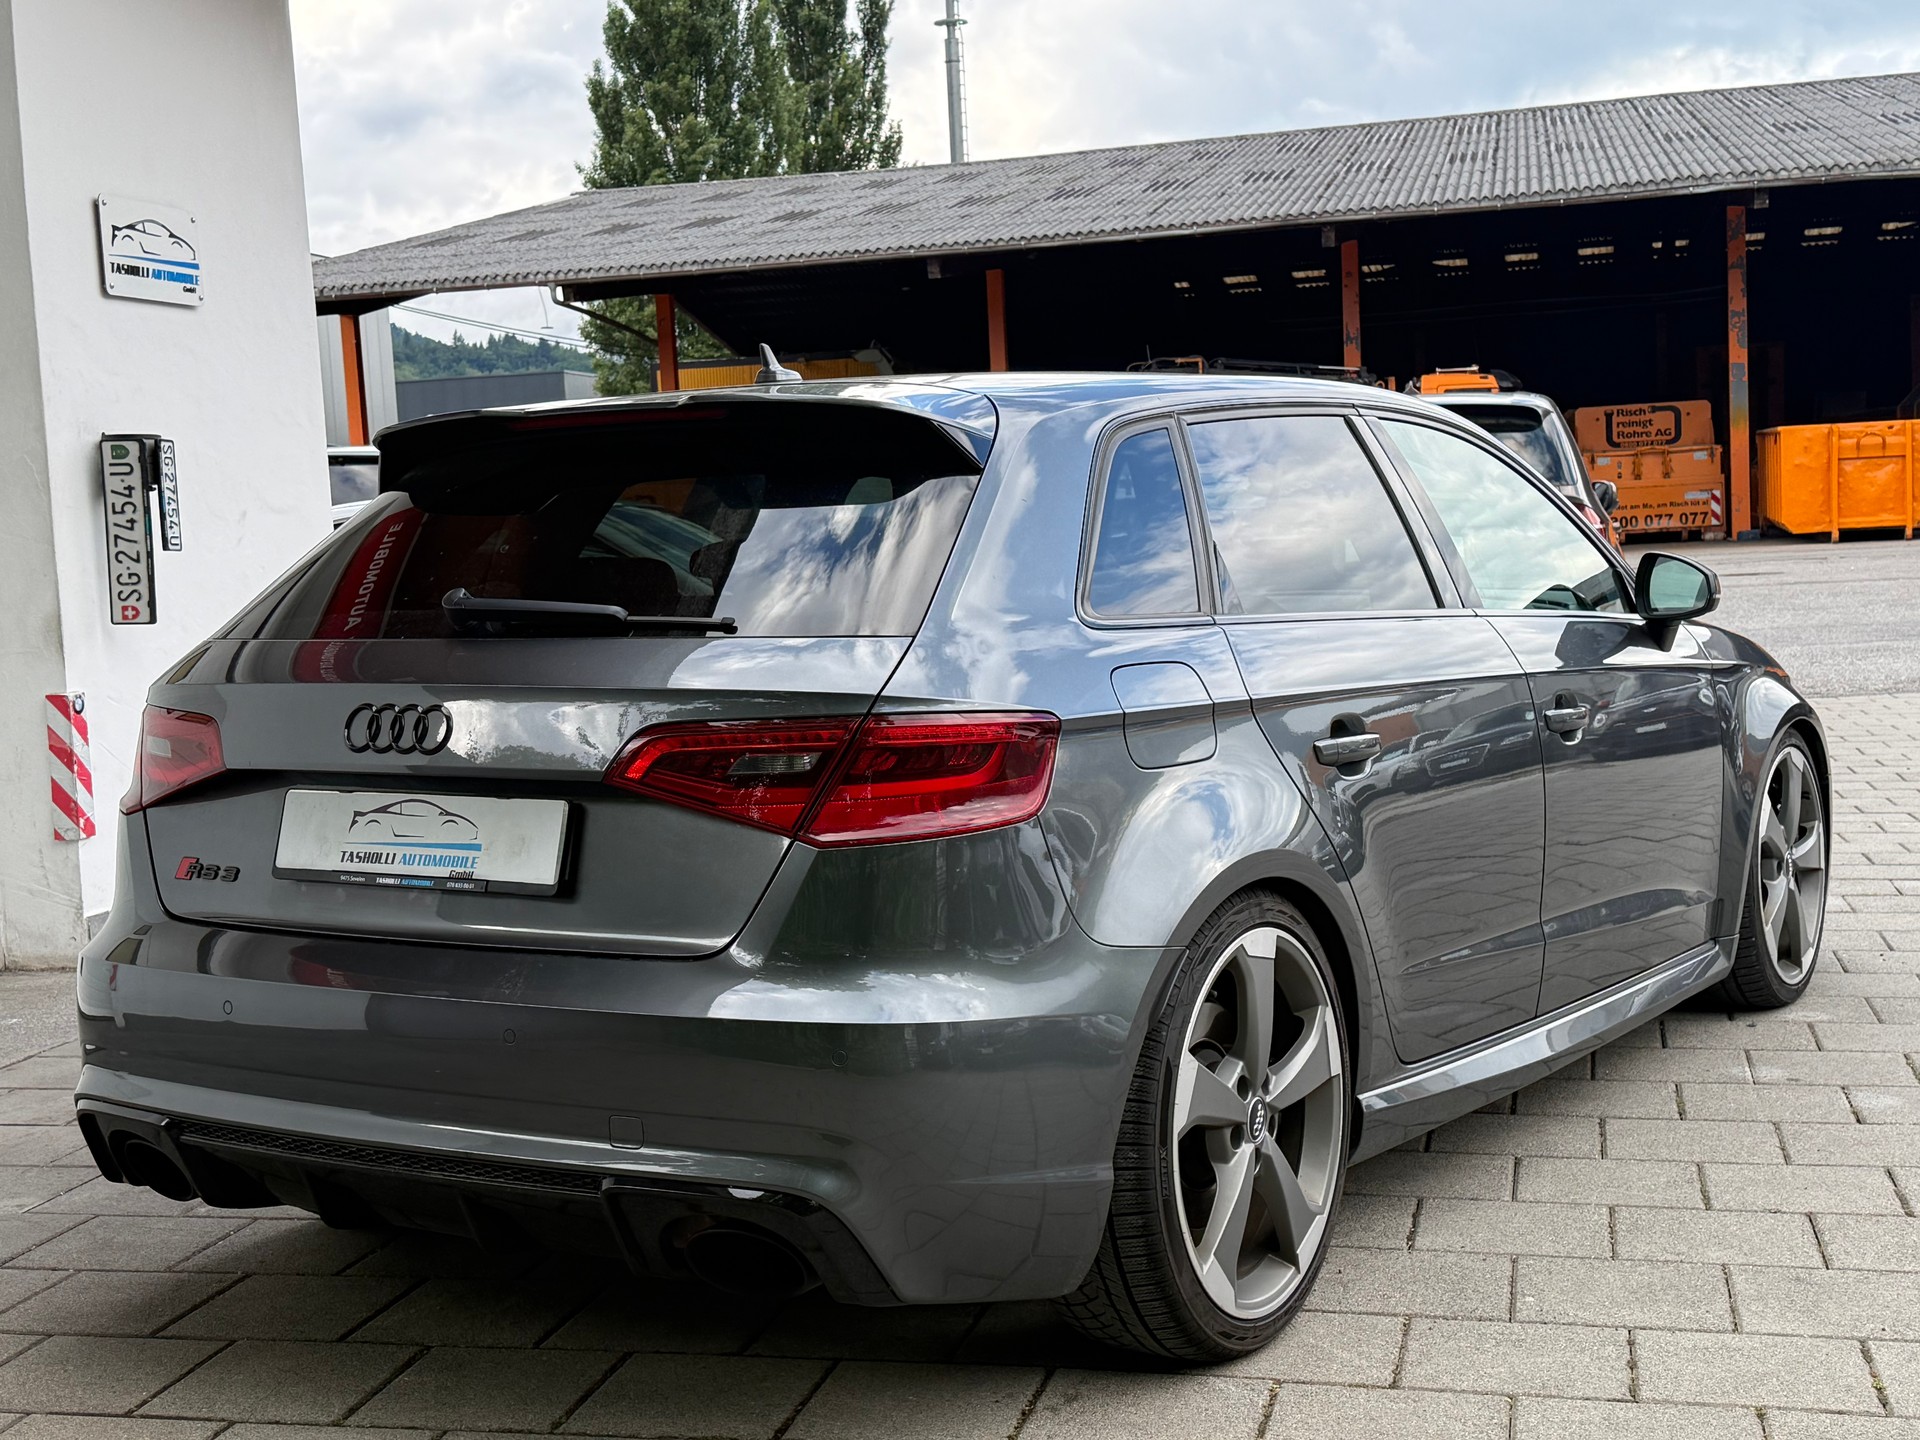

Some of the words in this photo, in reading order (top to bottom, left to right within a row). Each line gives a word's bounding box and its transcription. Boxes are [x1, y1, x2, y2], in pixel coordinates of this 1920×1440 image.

[151, 268, 200, 286] AUTOMOBILE
[183, 285, 197, 294] GmbH
[1616, 408, 1646, 417] Risch
[1616, 418, 1654, 429] reinigt
[1617, 430, 1652, 439] Rohre
[1655, 428, 1672, 437] AG
[1644, 513, 1674, 527] 077
[1679, 511, 1709, 525] 077
[340, 850, 397, 865] TASHOLLI
[398, 853, 480, 870] AUTOMOBILE
[448, 869, 475, 879] GmbH
